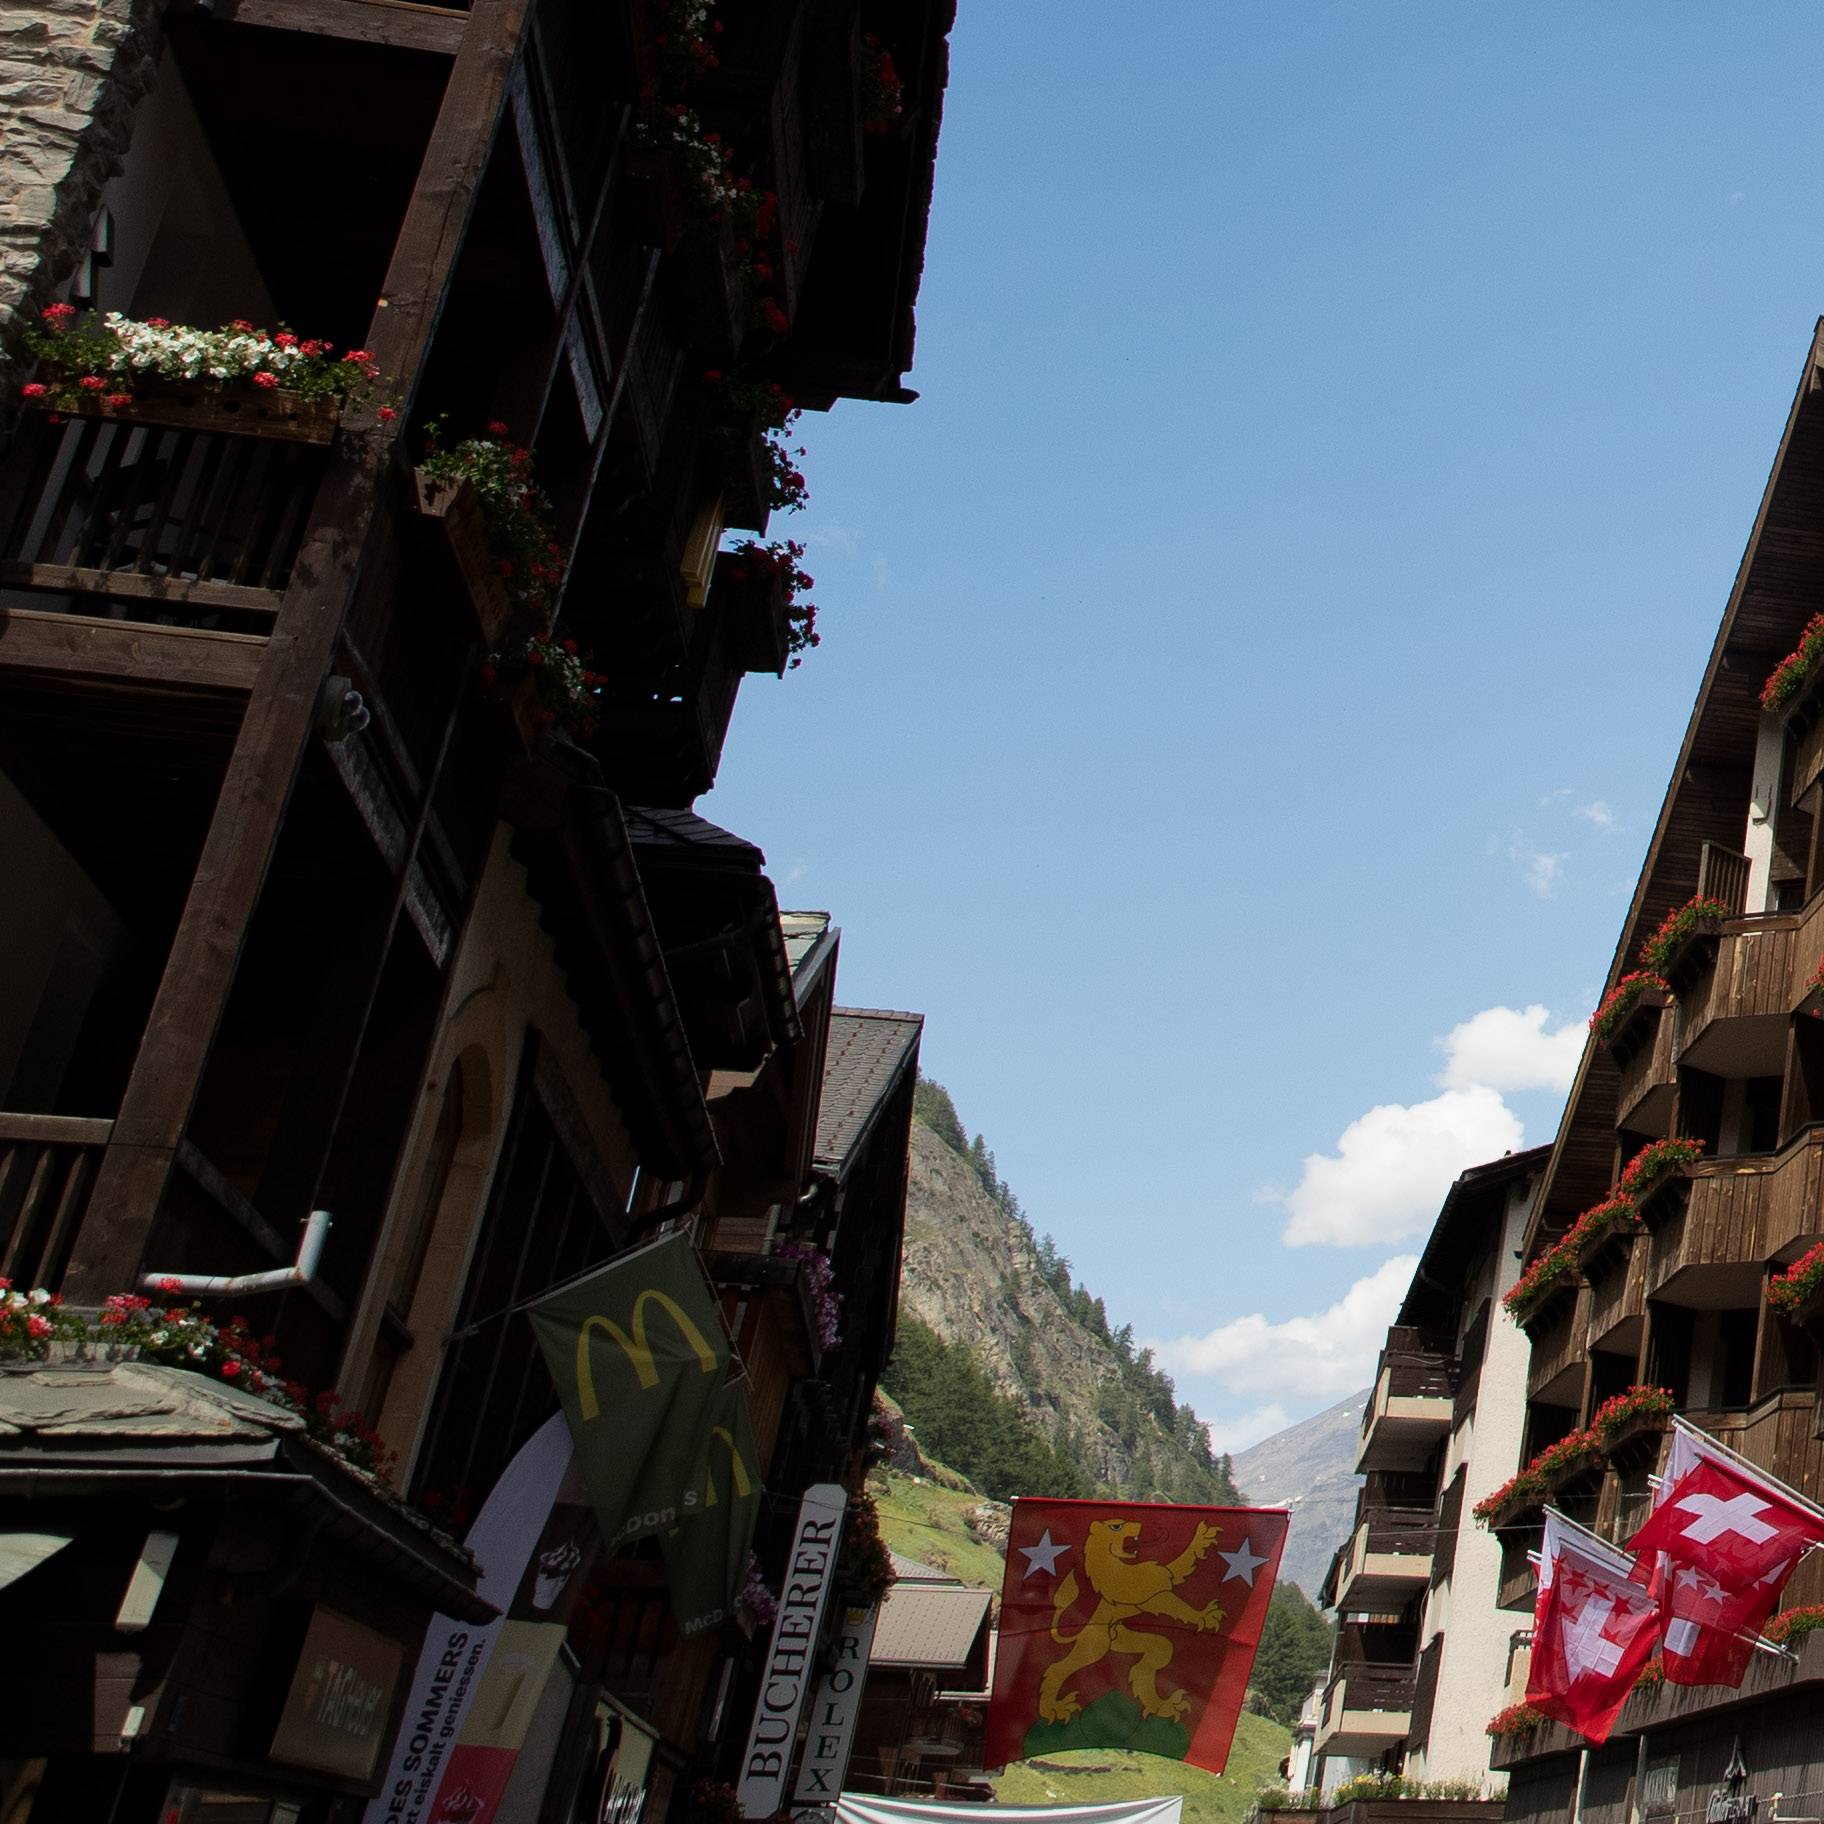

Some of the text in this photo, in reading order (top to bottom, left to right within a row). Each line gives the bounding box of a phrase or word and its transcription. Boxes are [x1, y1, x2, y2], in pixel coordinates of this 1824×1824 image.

[404, 1632, 468, 1772] SOMMERS
[414, 1742, 445, 1805] eiskalt
[440, 1639, 487, 1738] geniessen.
[747, 1519, 836, 1782] BUCHERER
[806, 1636, 859, 1792] ROLEX
